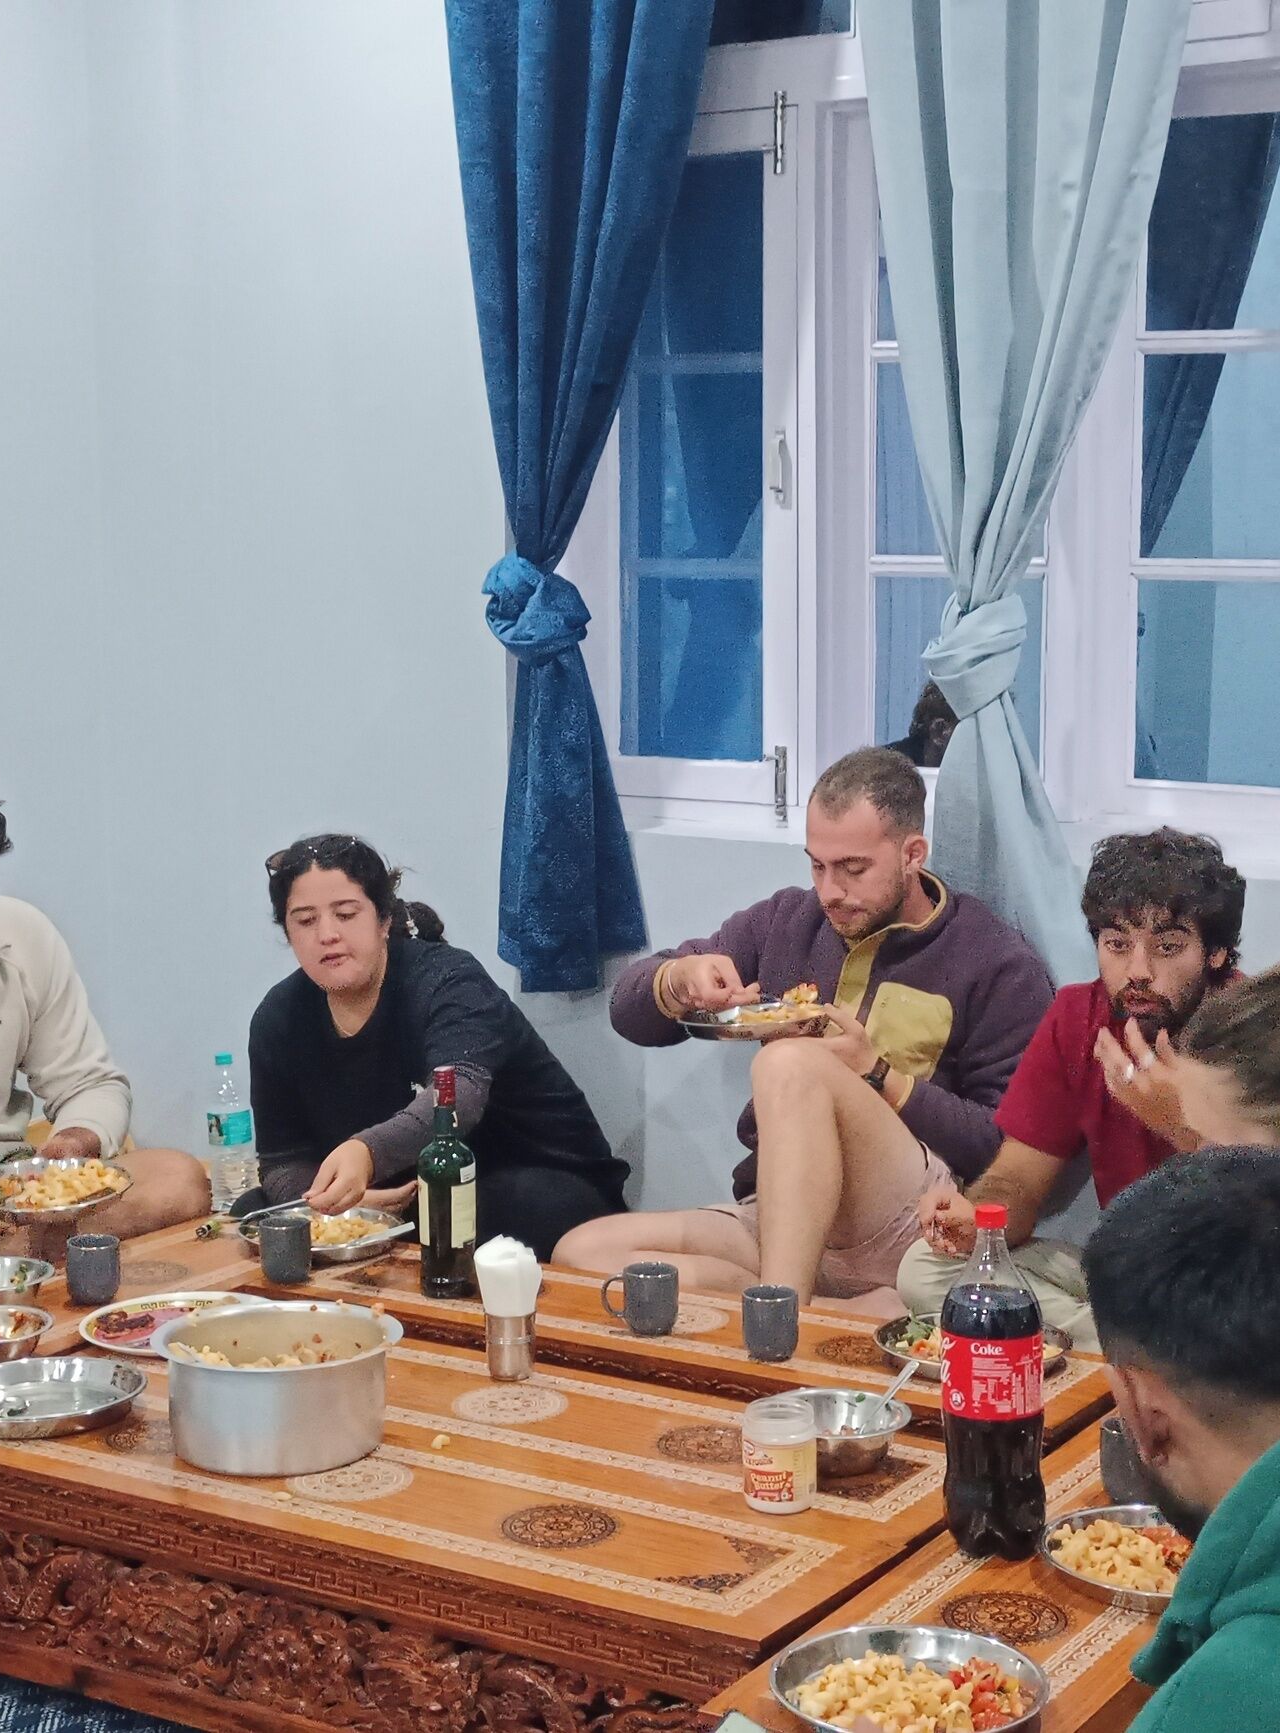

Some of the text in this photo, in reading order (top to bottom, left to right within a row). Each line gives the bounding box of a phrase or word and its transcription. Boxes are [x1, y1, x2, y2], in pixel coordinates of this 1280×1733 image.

[970, 1342, 1003, 1355] Coke
[750, 1471, 787, 1483] Peanut
[753, 1481, 786, 1491] Butter
